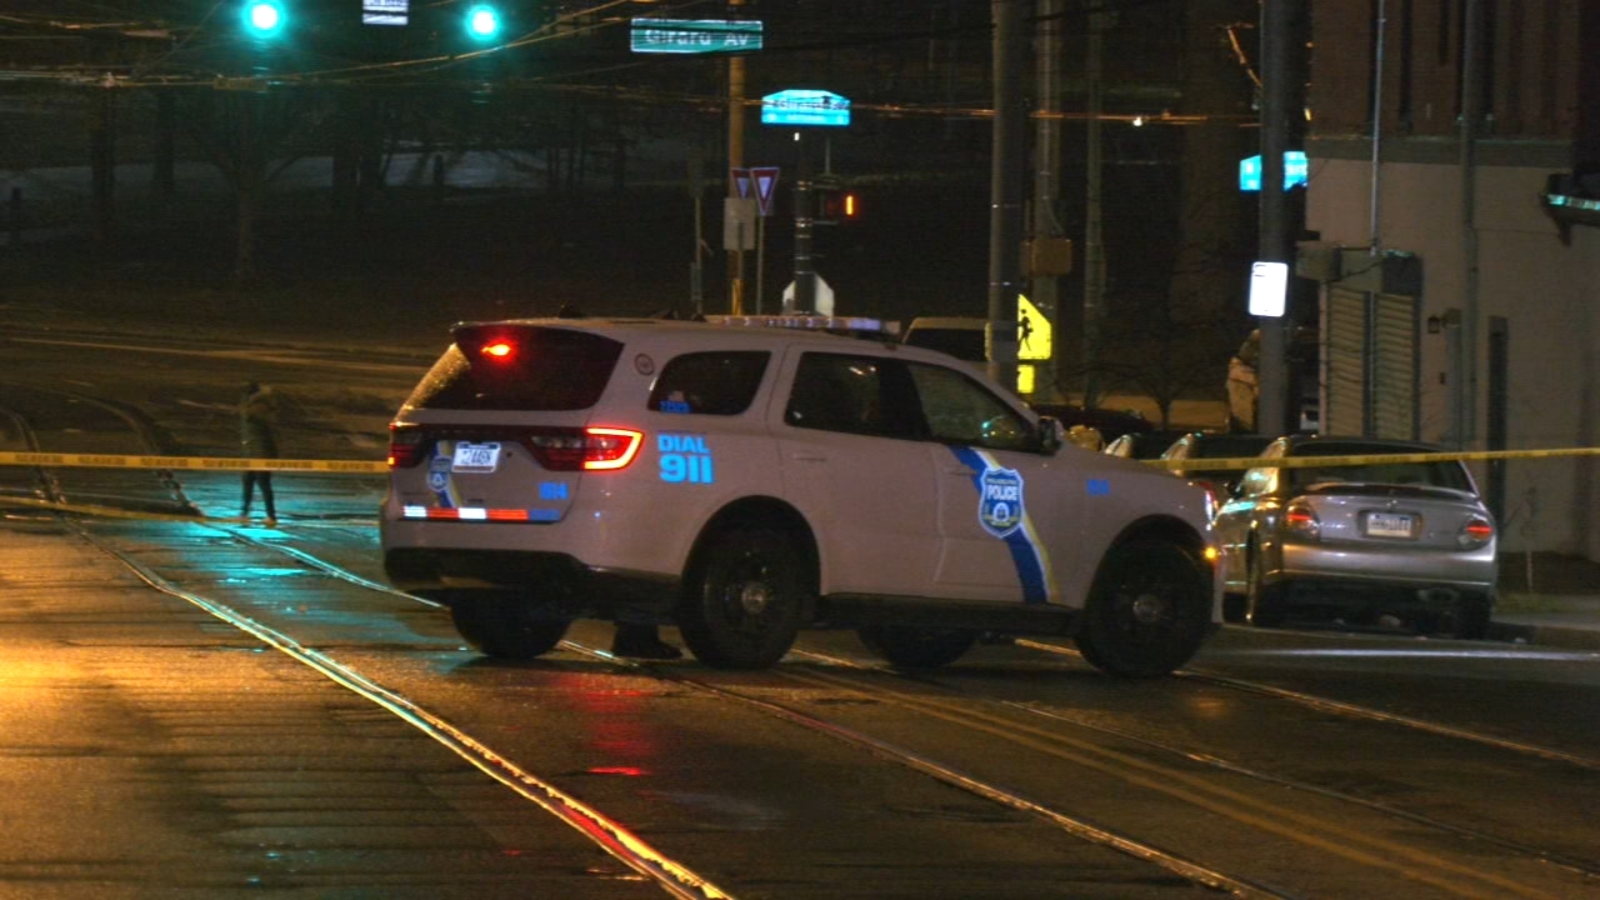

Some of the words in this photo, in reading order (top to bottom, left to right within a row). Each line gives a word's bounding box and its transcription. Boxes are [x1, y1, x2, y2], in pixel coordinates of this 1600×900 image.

[658, 434, 711, 453] DIAL
[659, 454, 714, 484] 911
[986, 484, 1018, 501] POLICE
